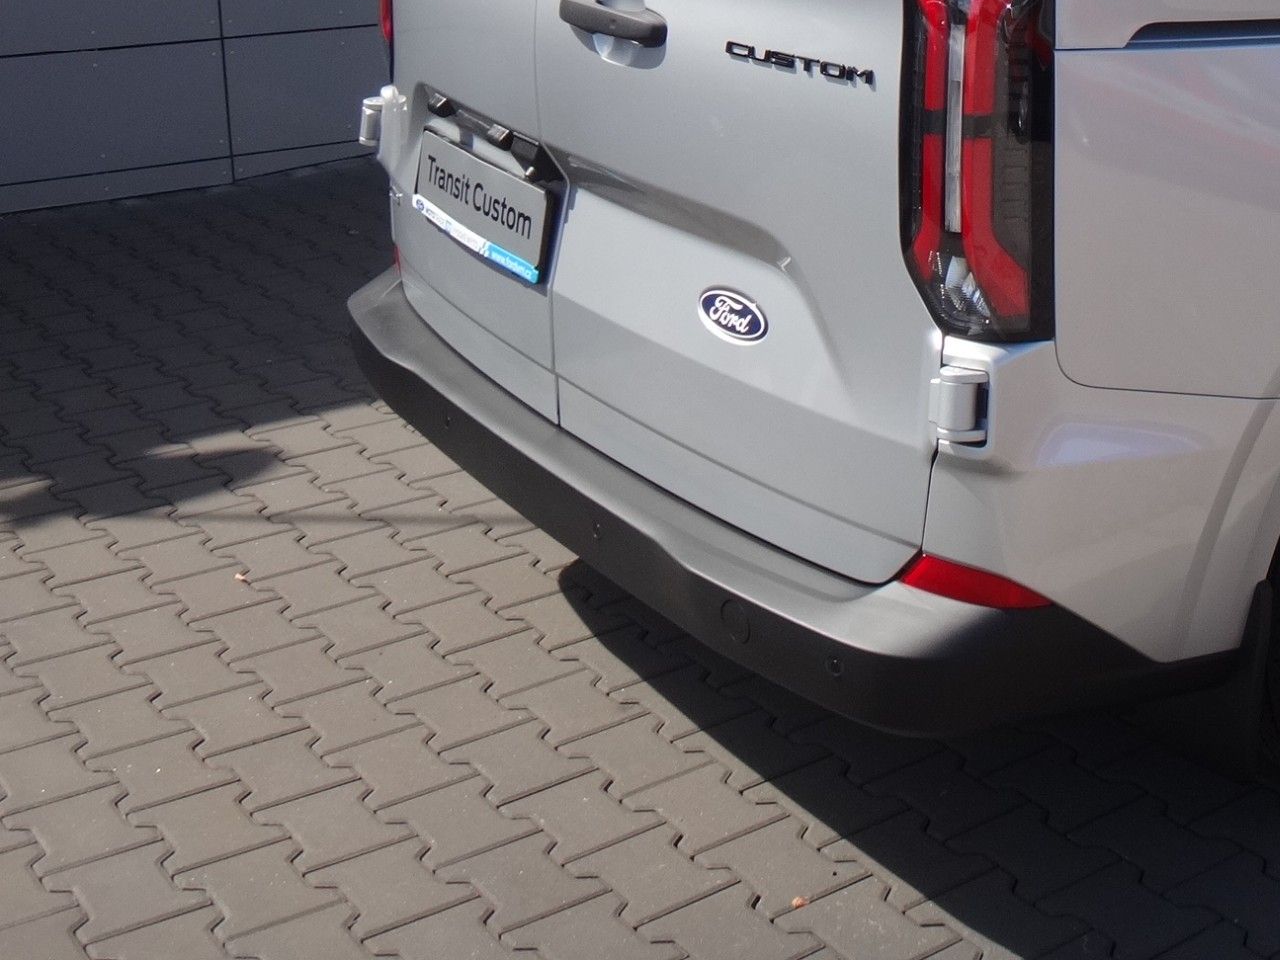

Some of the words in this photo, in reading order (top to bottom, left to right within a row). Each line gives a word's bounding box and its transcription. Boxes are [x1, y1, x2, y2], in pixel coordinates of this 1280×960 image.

[725, 40, 874, 86] CUSTOM
[428, 155, 471, 205] Transit
[472, 182, 532, 240] Custom
[709, 295, 752, 333] Ford
